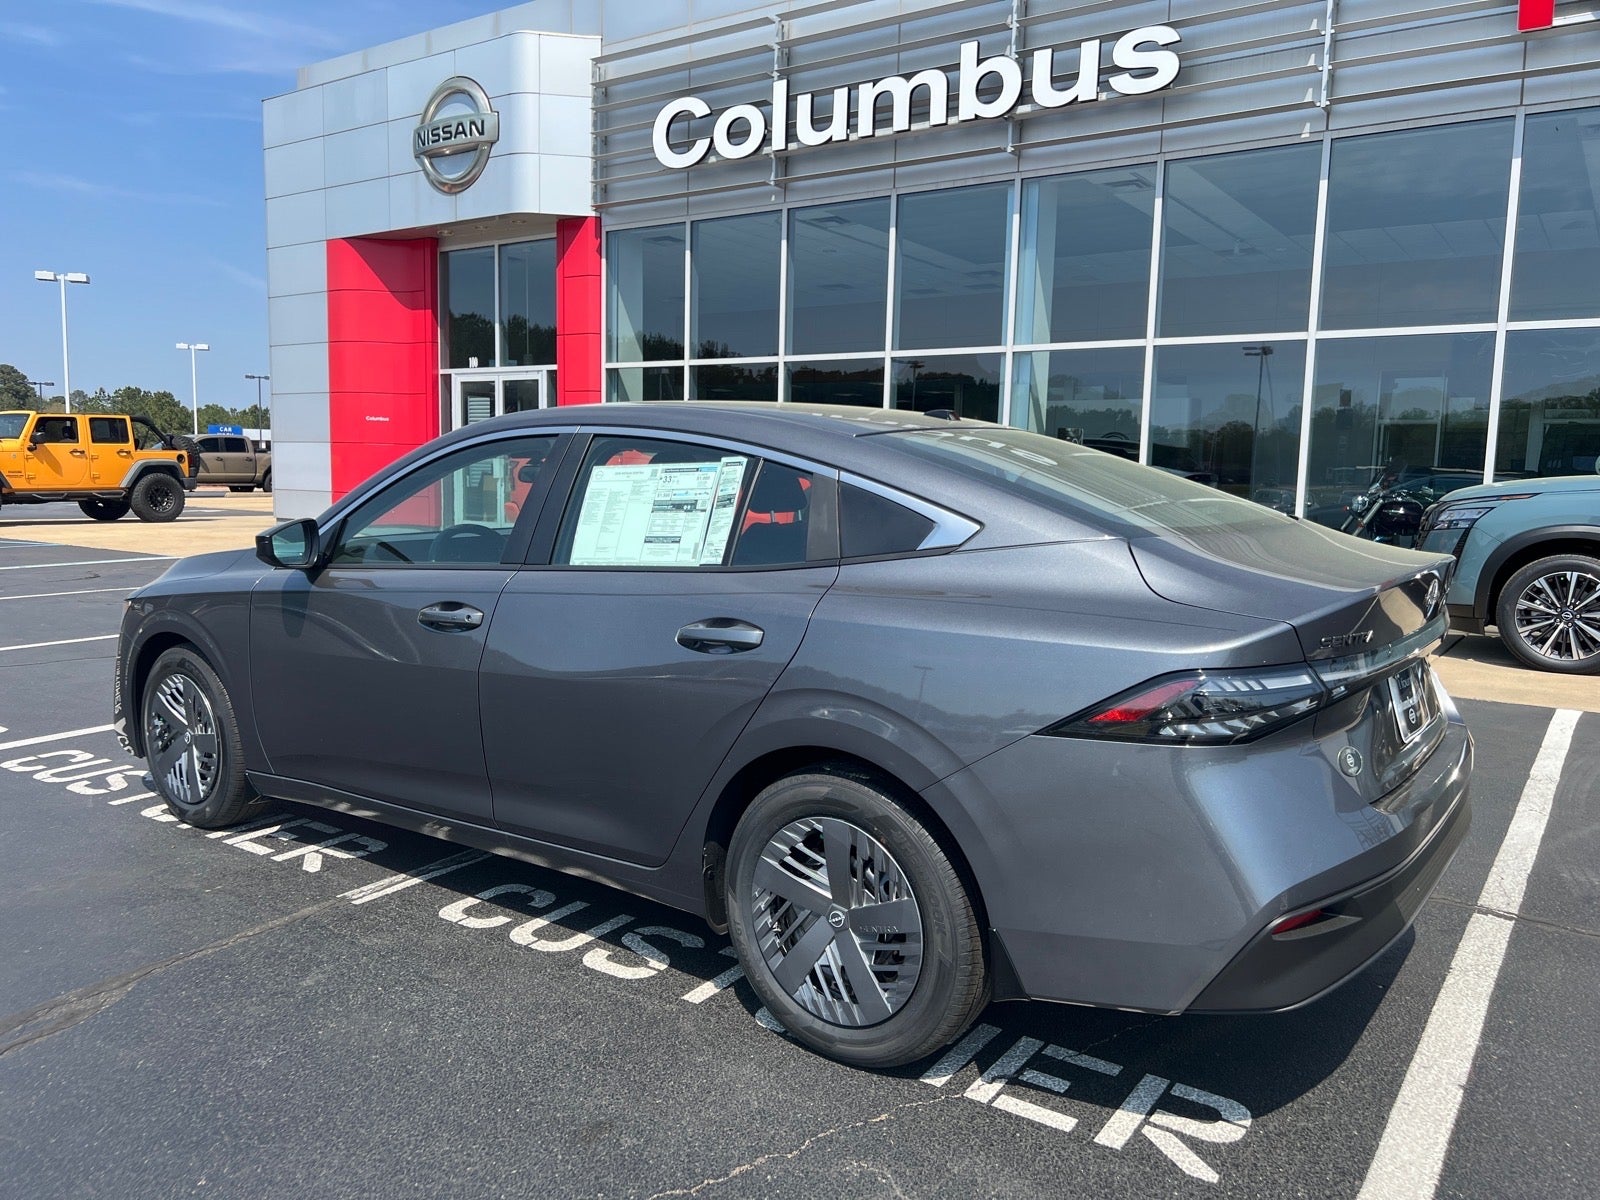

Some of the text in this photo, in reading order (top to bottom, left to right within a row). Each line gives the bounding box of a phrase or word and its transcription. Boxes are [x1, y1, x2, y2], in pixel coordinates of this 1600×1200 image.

[417, 119, 485, 148] NISSAN
[651, 24, 1182, 168] Columbus
[468, 356, 478, 368] 100
[438, 883, 1252, 1184] CUSTER
